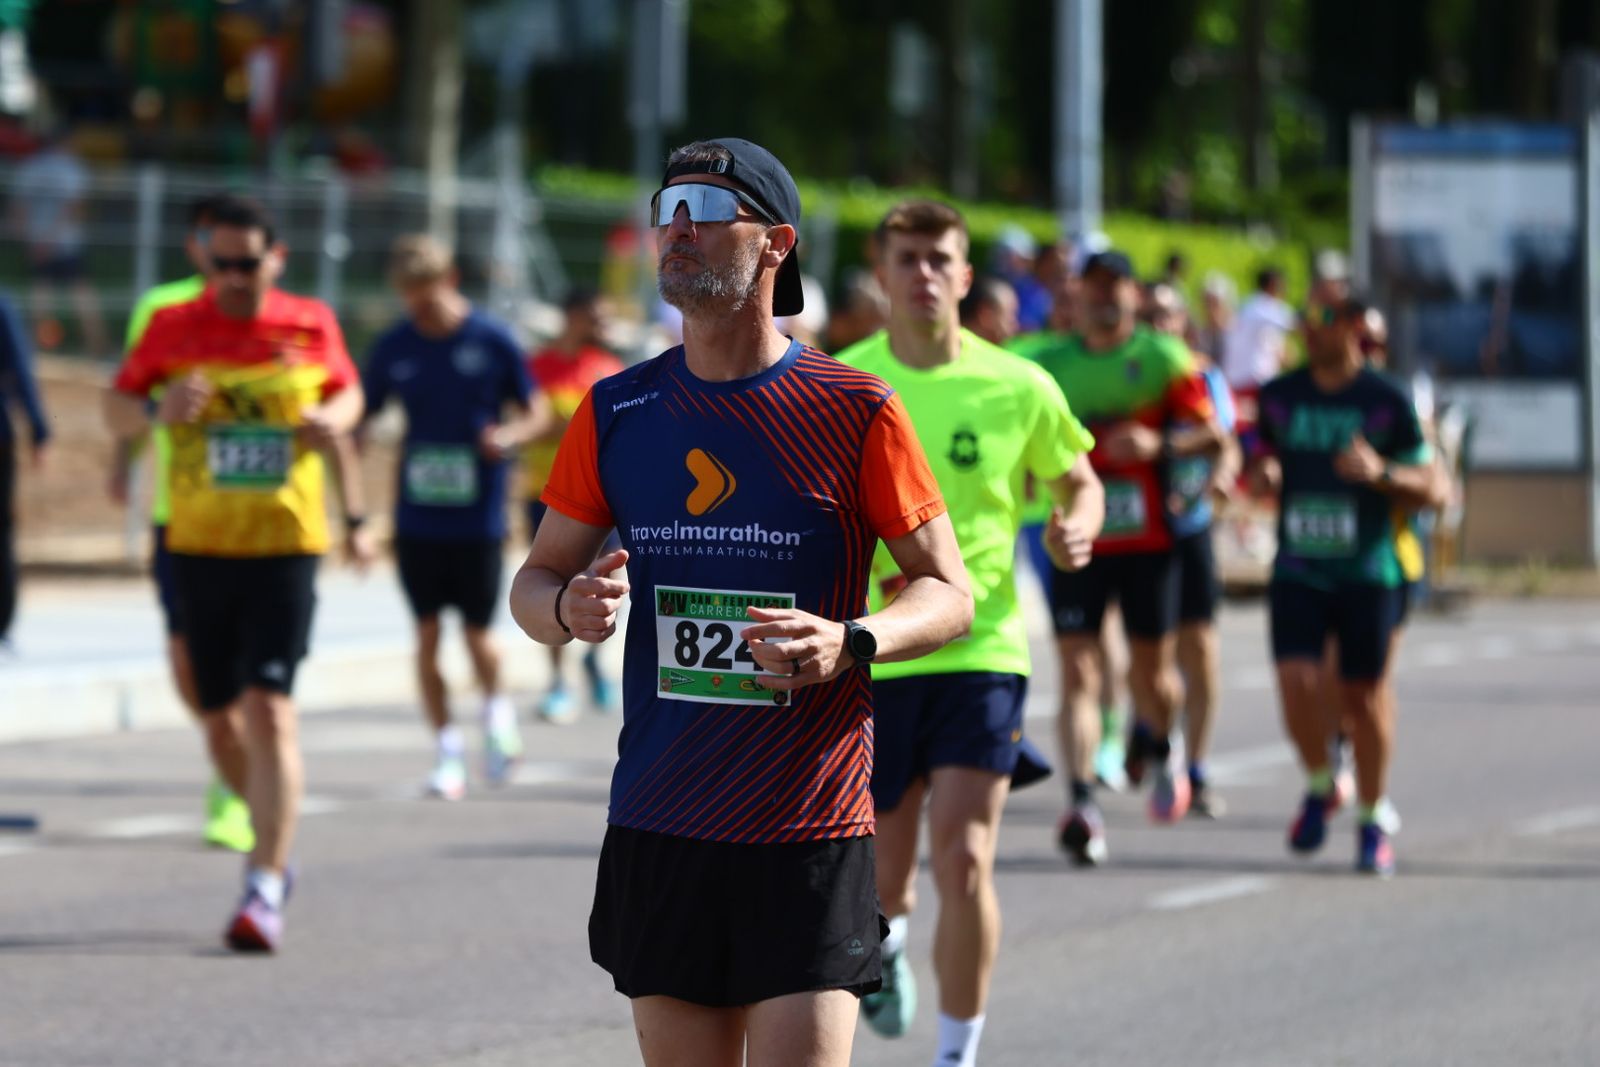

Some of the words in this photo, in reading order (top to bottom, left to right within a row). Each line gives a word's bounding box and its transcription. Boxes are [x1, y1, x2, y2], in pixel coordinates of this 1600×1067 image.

[630, 519, 800, 546] travelmarathon
[636, 545, 793, 560] TRAVELMARATHON.ES
[674, 620, 765, 672] 824
